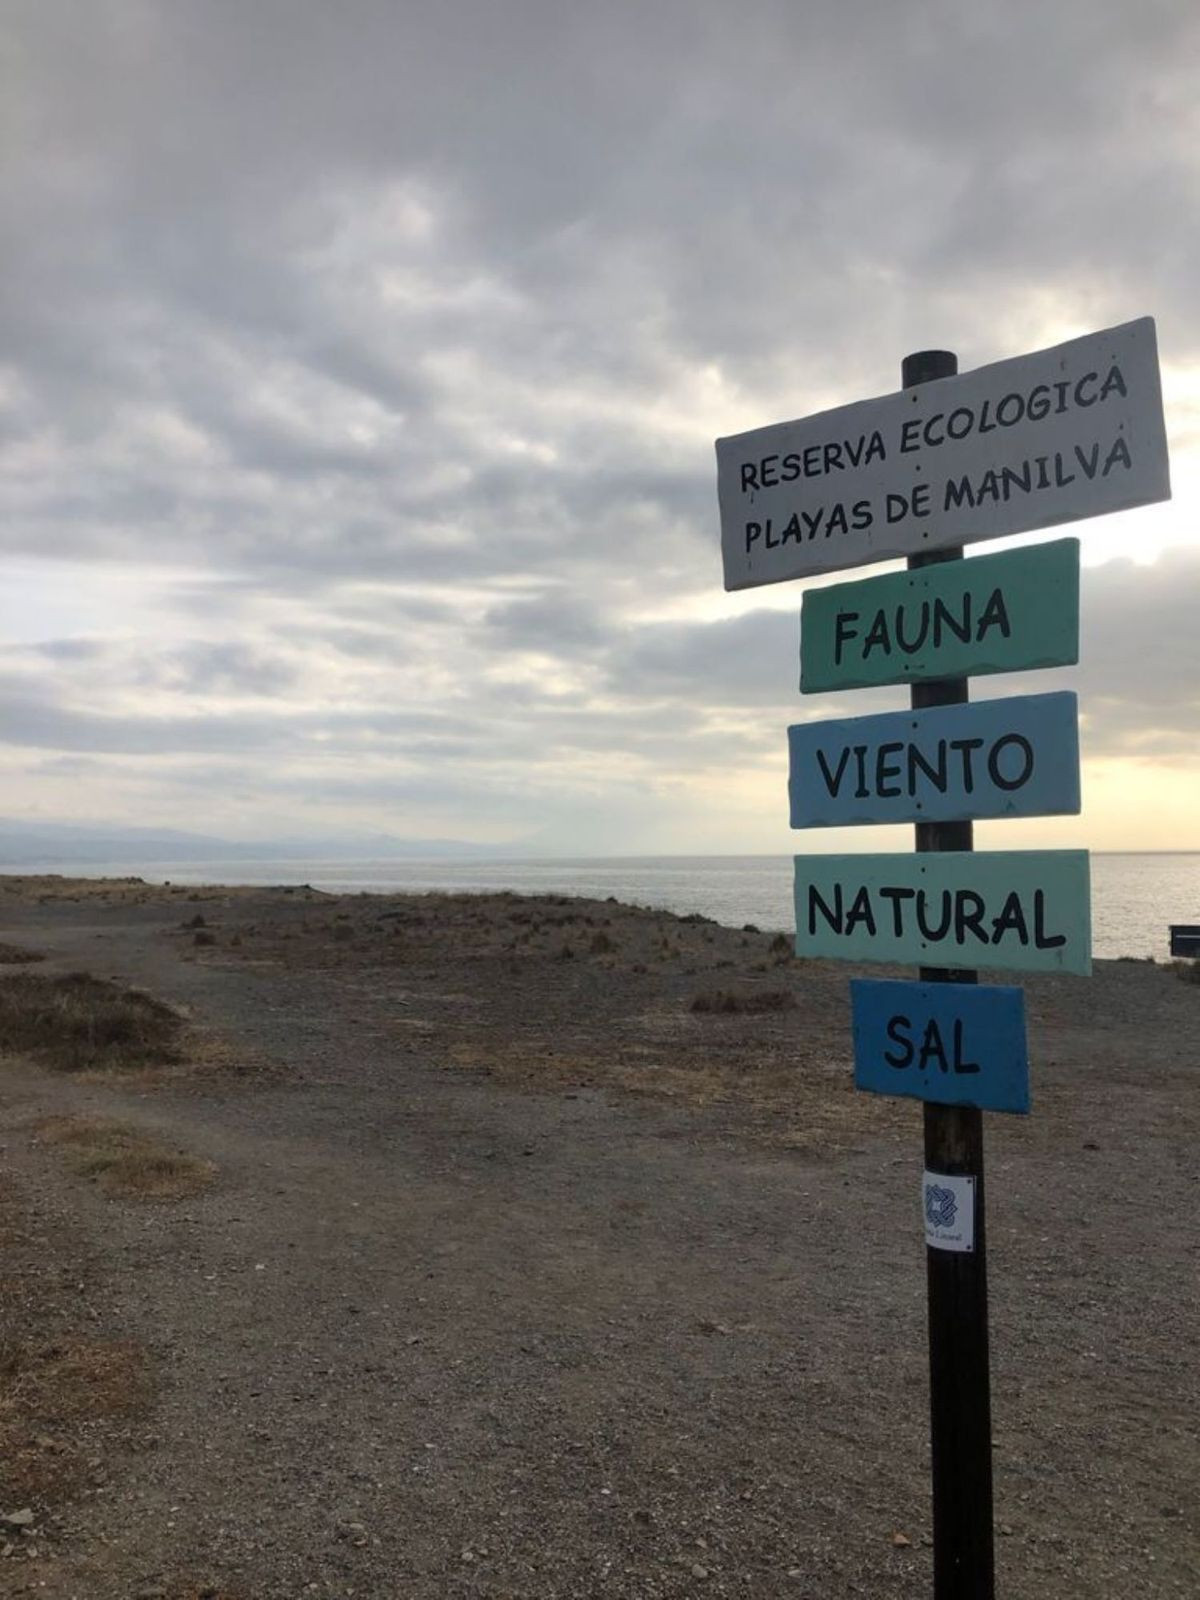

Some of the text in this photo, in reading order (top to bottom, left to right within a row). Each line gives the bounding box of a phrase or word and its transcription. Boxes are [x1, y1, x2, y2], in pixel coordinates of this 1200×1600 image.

[741, 366, 1127, 492] RESERVA ECOLOGICA
[746, 438, 1131, 552] PLAYAS DE MANILVA
[835, 588, 1010, 665] FAUNA
[816, 733, 1034, 798] VIENTO
[808, 883, 1066, 949] NATURAL
[884, 1015, 980, 1075] SAL
